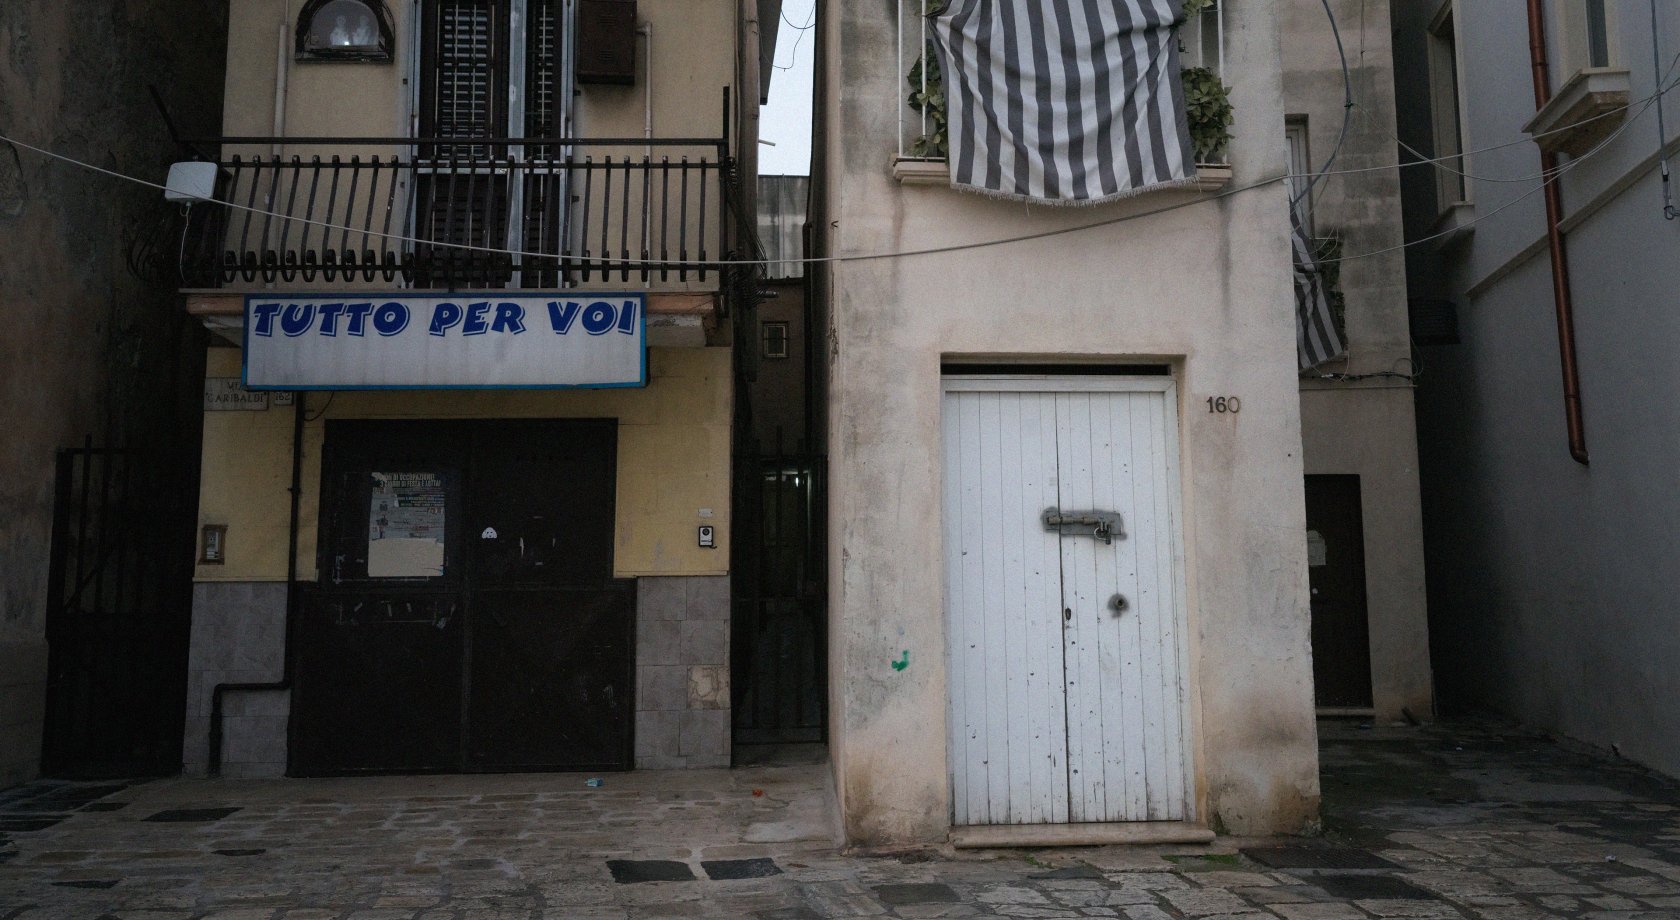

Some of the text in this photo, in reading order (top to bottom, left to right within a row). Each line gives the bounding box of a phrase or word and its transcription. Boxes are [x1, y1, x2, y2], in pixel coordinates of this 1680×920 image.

[254, 301, 636, 336] TUTTO PER VOI
[1206, 396, 1240, 414] 160
